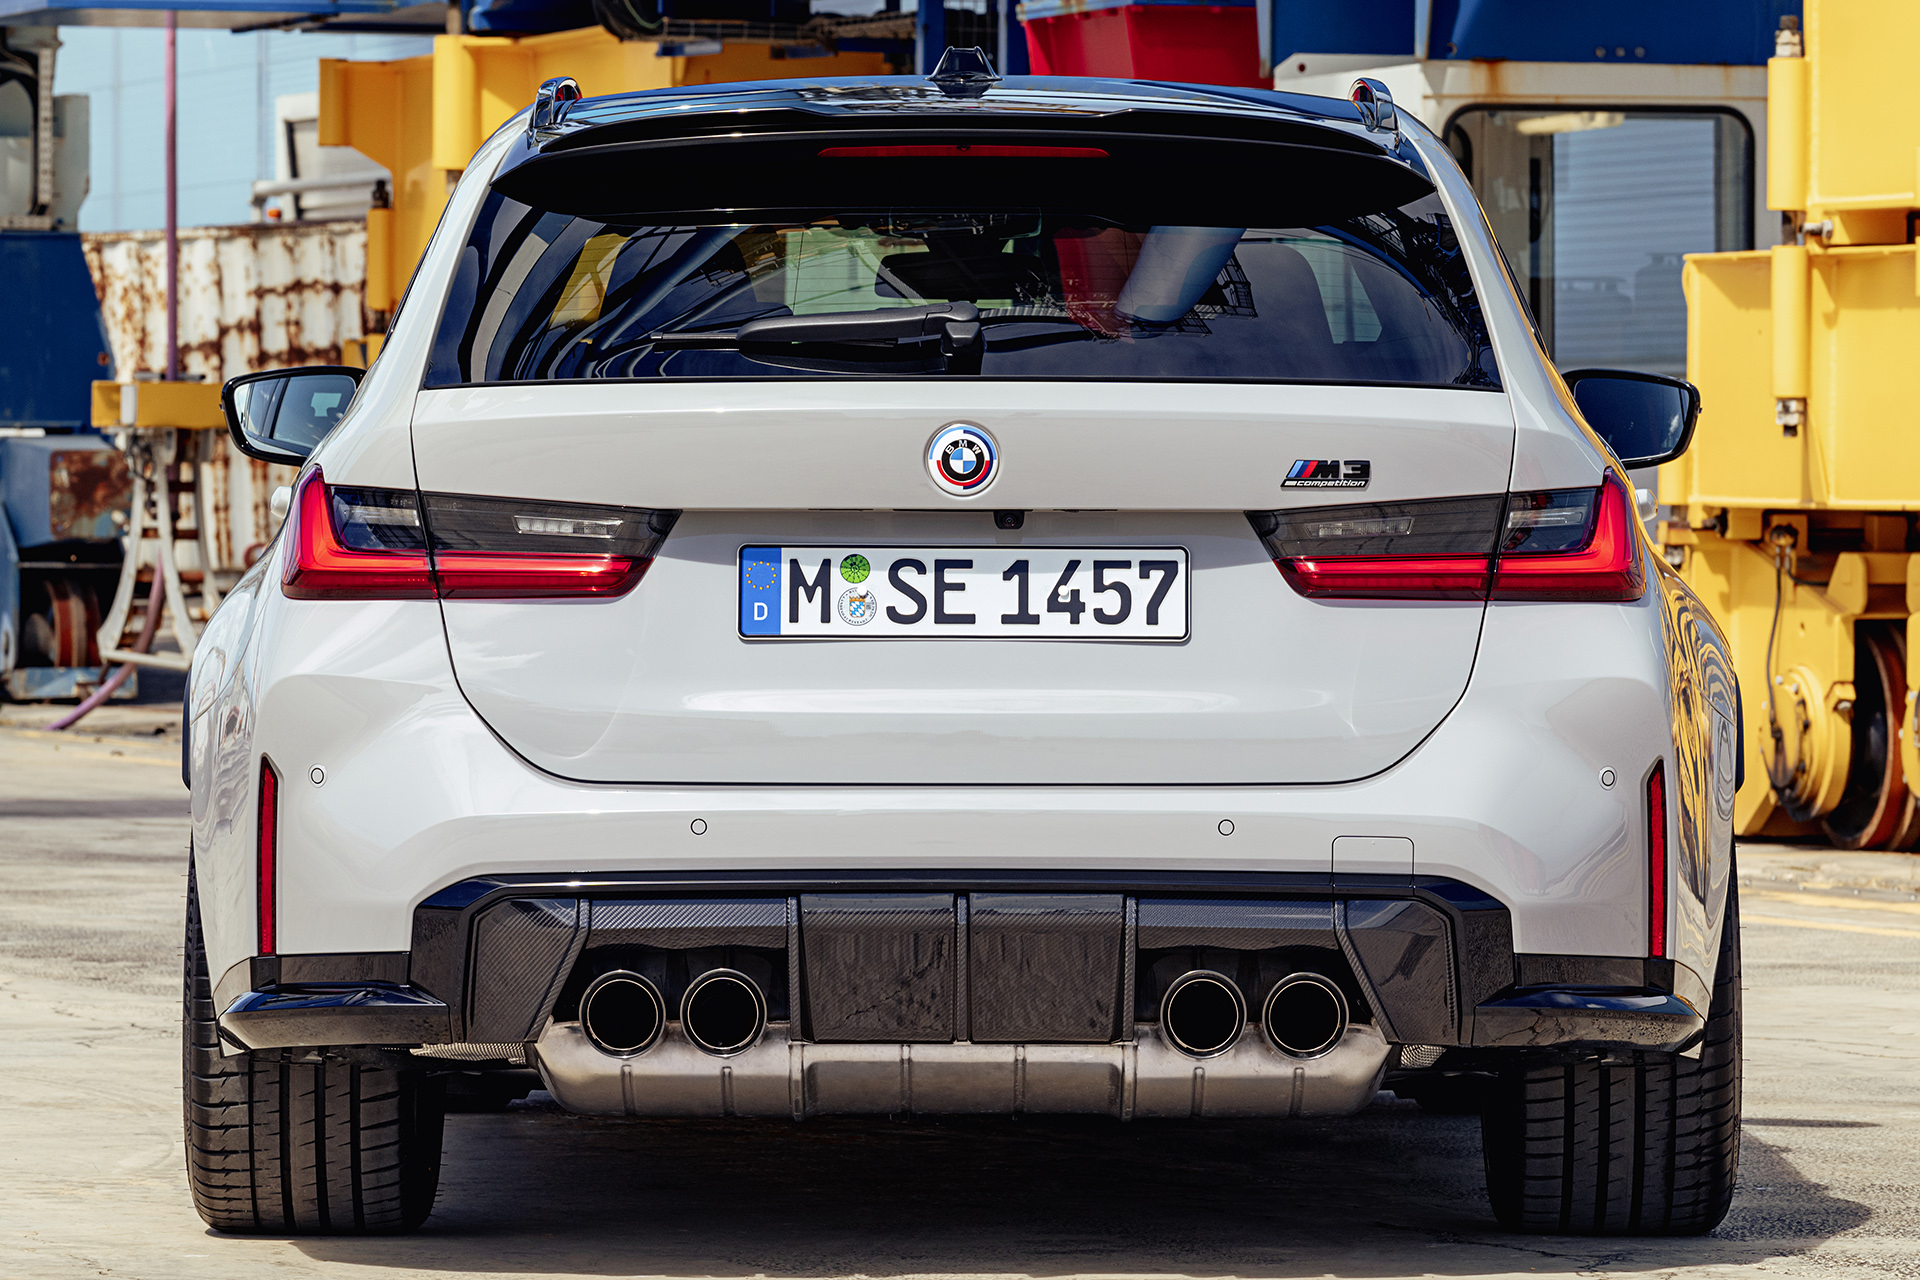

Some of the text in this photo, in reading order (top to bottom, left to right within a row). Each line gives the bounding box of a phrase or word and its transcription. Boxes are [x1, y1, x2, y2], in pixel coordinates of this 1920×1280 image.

[945, 440, 982, 455] BMW
[1296, 480, 1366, 488] competition
[788, 558, 832, 625] M
[885, 558, 977, 626] SE
[1000, 559, 1180, 627] 1457
[753, 602, 769, 622] D
